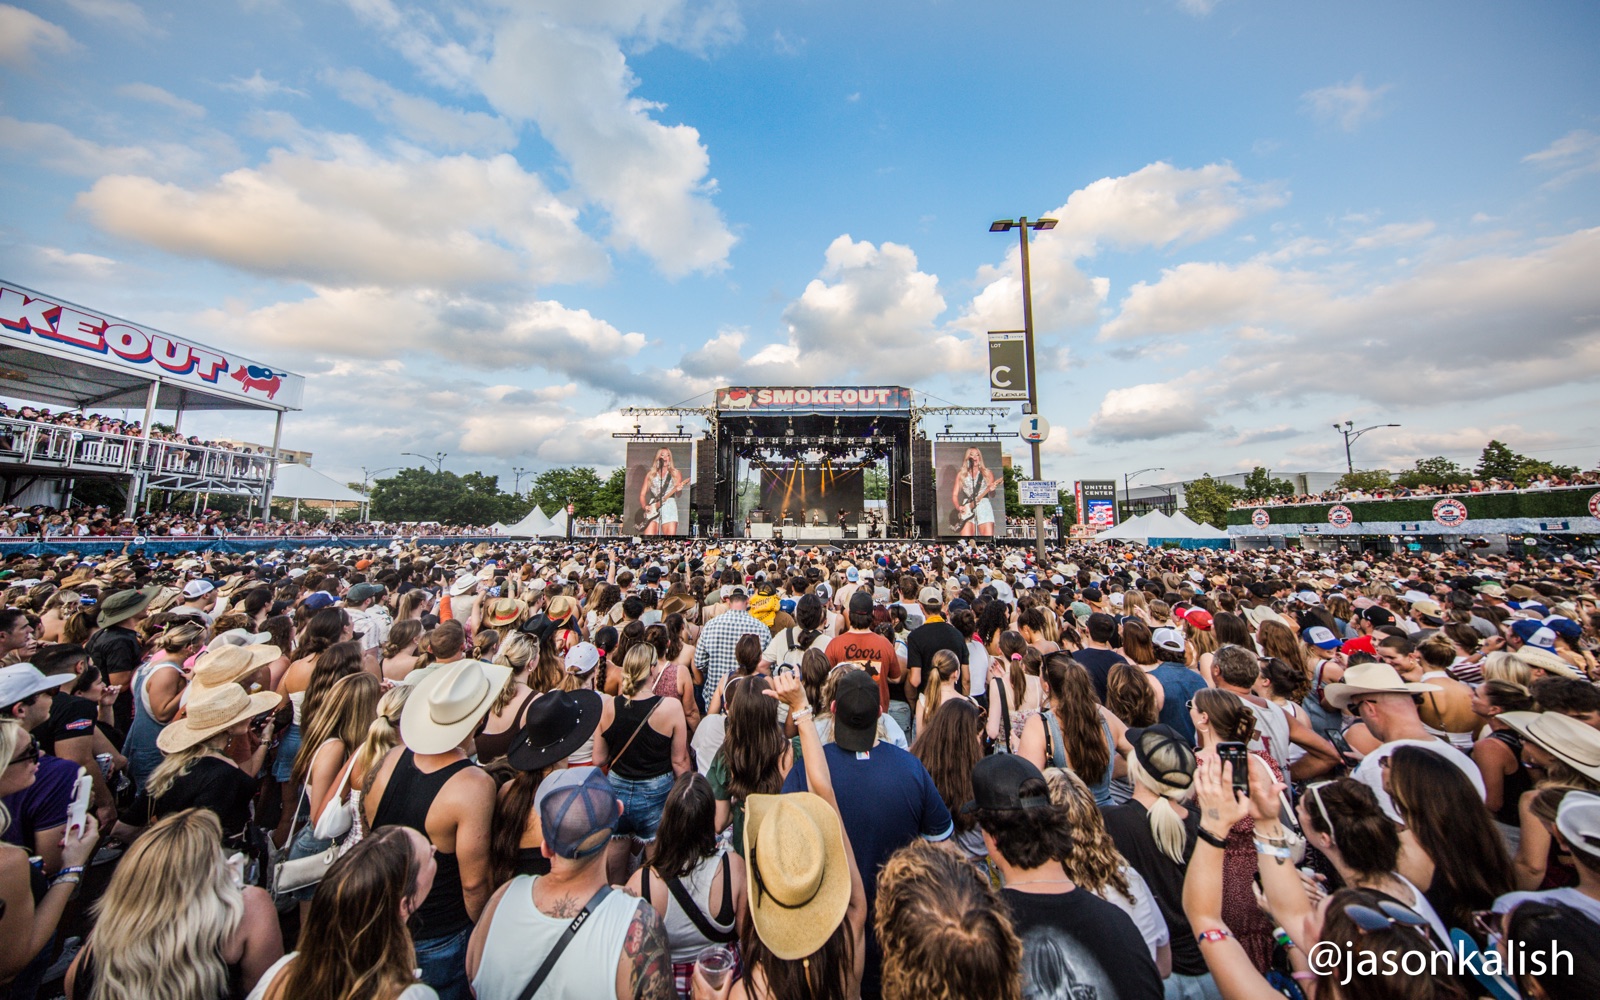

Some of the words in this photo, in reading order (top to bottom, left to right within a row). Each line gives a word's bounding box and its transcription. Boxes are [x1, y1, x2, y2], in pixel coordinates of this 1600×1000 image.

[991, 366, 1012, 388] C
[757, 389, 892, 405] SMOKEOUT
[1030, 418, 1038, 430] 1
[844, 644, 882, 660] Coors
[572, 912, 588, 931] YETI
